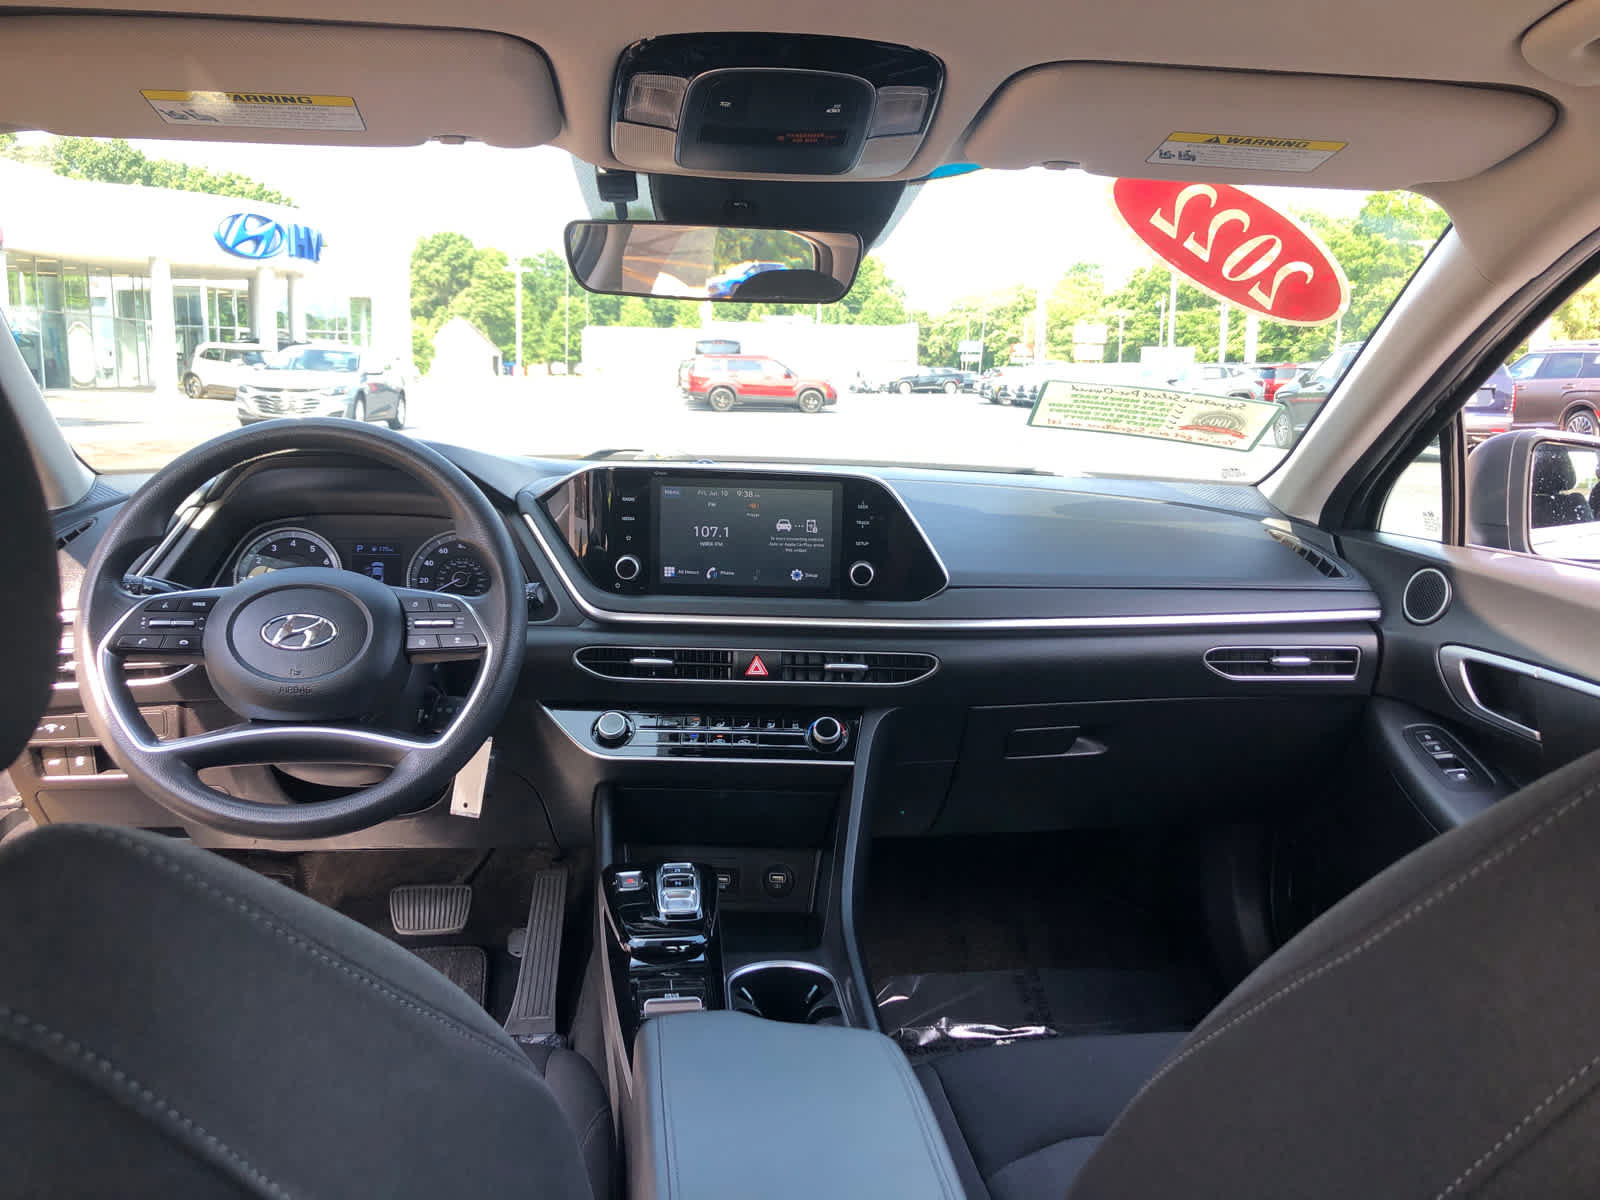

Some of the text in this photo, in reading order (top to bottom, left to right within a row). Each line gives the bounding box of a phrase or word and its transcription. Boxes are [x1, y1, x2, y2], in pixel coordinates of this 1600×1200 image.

[1226, 136, 1312, 148] WARNING
[693, 526, 729, 538] 107.1
[290, 539, 296, 547] 4
[271, 544, 277, 552] 3
[309, 545, 316, 553] 5
[356, 544, 364, 552] P
